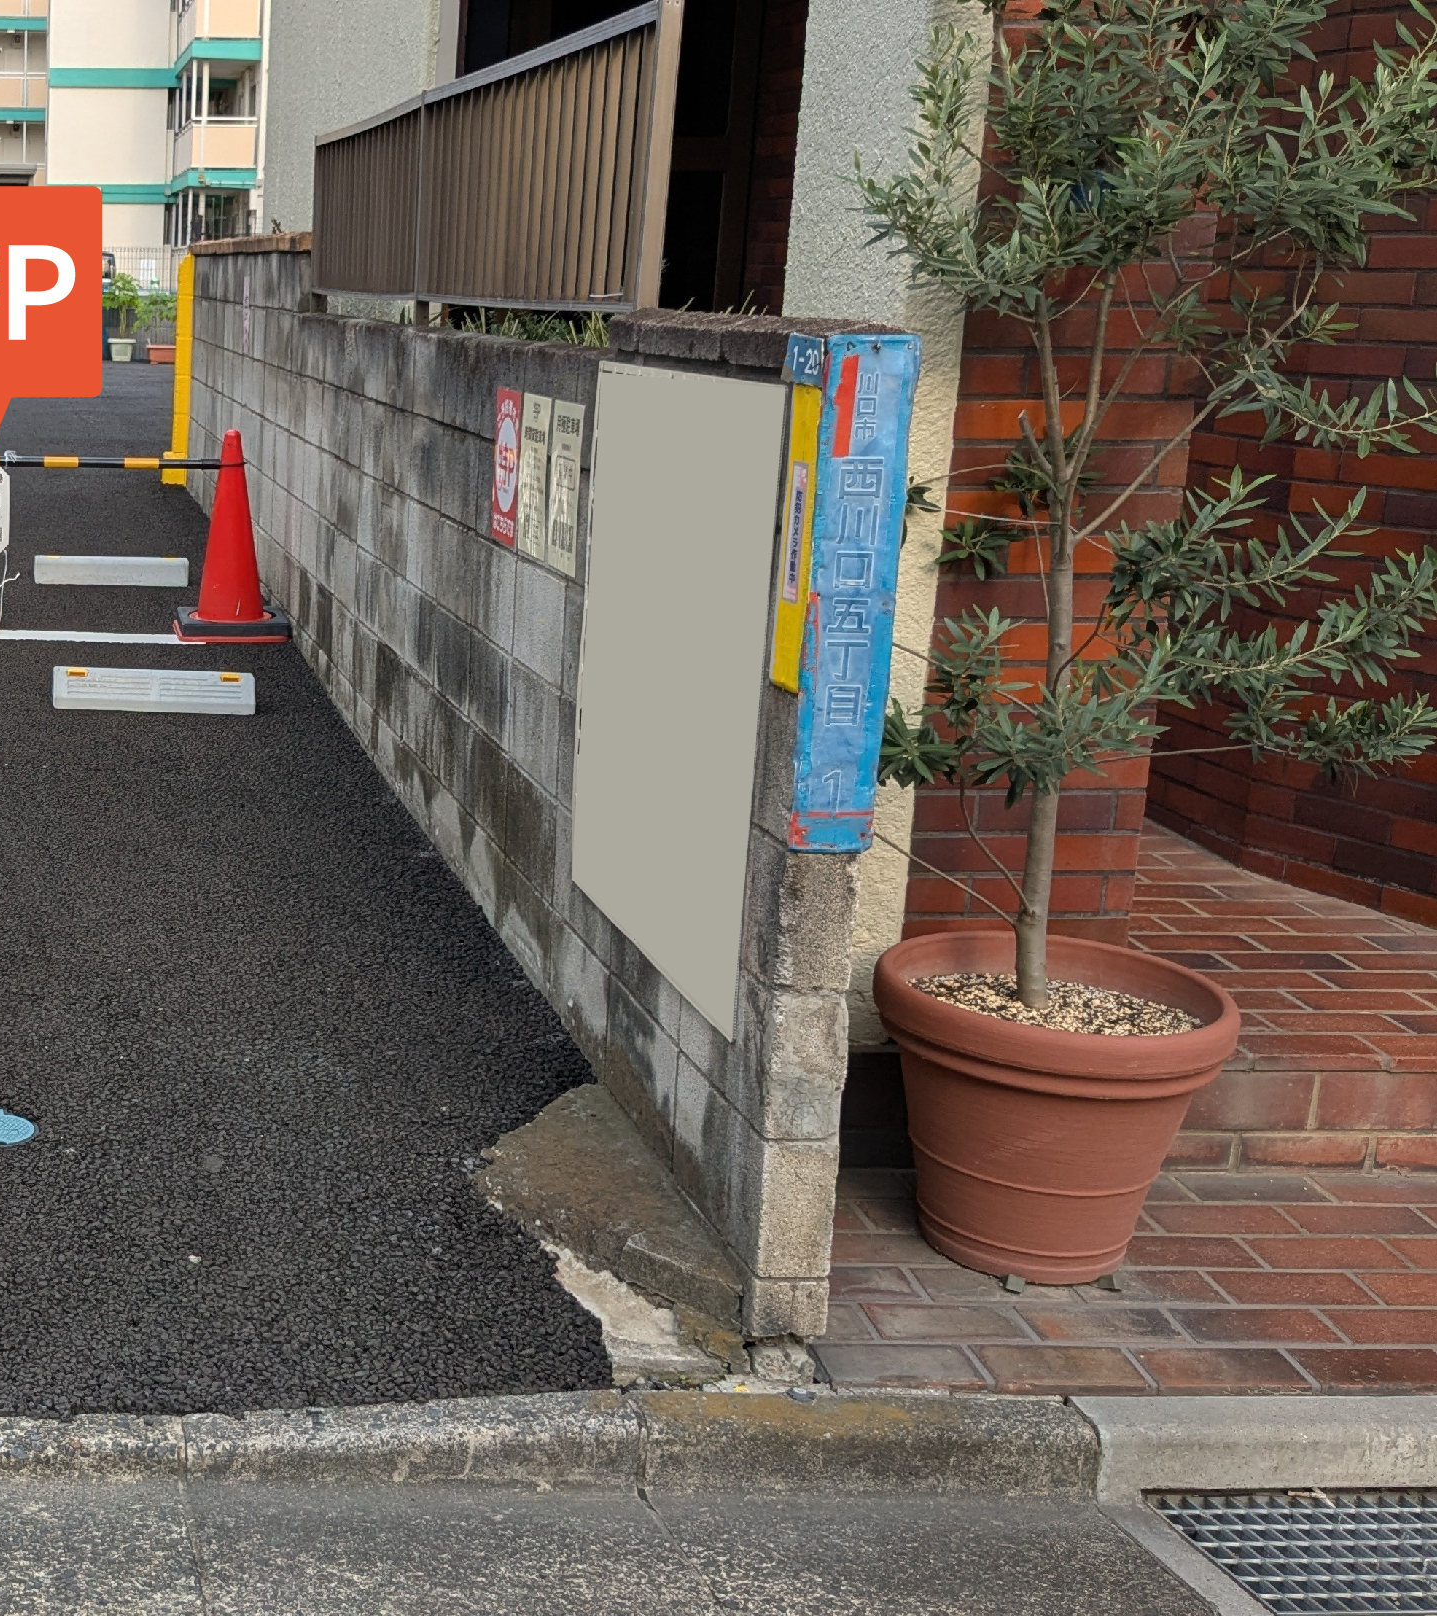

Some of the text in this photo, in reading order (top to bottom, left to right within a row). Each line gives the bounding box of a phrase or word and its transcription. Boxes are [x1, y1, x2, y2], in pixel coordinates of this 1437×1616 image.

[793, 346, 819, 376] 1-20
[854, 372, 880, 440] 川口市
[822, 456, 885, 814] 西川口五丁目 1
